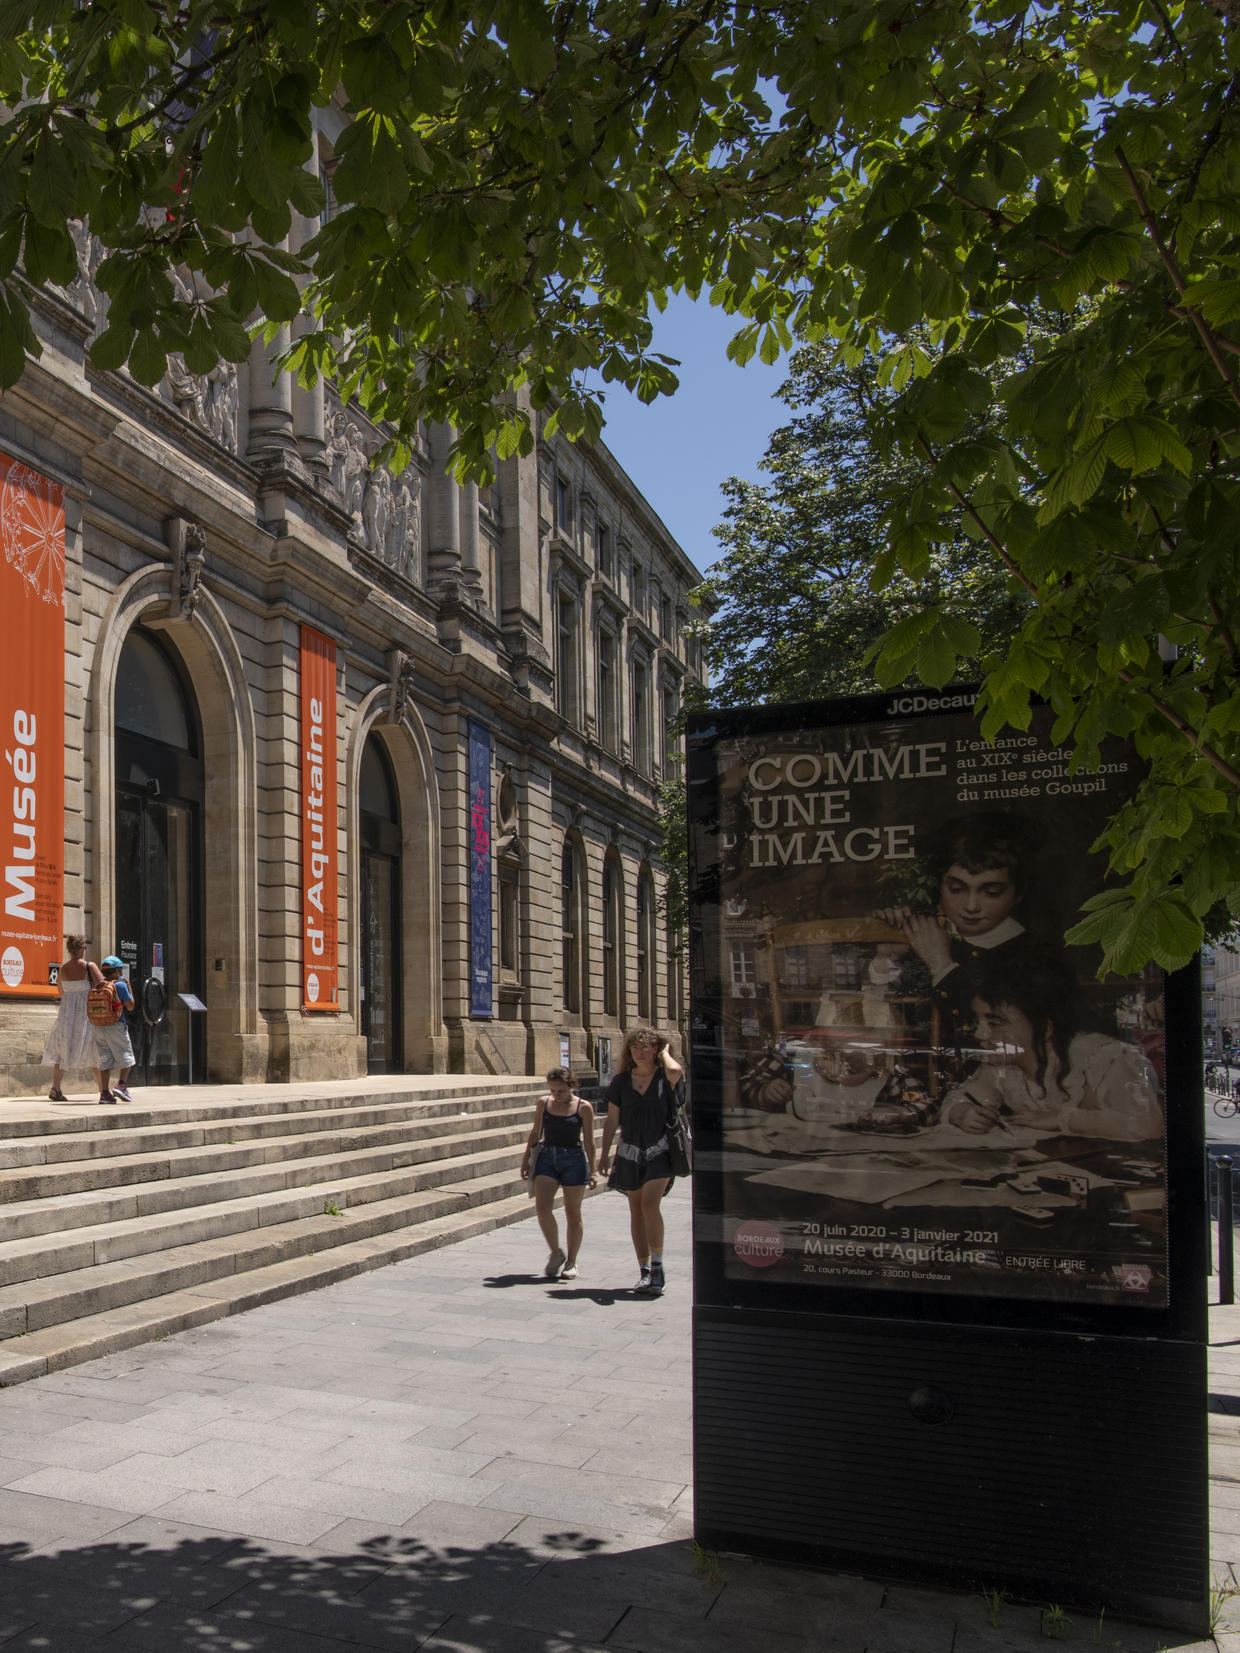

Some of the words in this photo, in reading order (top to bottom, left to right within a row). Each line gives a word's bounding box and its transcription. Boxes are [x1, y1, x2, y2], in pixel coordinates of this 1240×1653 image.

[887, 694, 979, 715] JCDecau
[748, 741, 947, 791] COMME
[957, 757, 976, 769] au
[1022, 748, 1074, 764] siècle
[957, 772, 998, 785] dans
[1002, 769, 1027, 782] les
[957, 788, 979, 801] du
[983, 784, 1041, 800] musée
[1045, 778, 1108, 797] Goupil
[5, 709, 36, 922] Musée
[749, 789, 851, 829] UNE
[307, 697, 329, 956] d'Aquitaine
[749, 824, 916, 868] IMAGE
[737, 1234, 780, 1245] BORDEAUX
[802, 1223, 820, 1235] 20
[823, 1224, 847, 1238] juin
[850, 1225, 887, 1238] 2020
[900, 1228, 910, 1239] 3
[913, 1229, 960, 1243] janvier
[963, 1230, 1000, 1244] 2021
[734, 1243, 785, 1258] culture
[803, 1239, 866, 1258] Musée
[872, 1243, 987, 1265] d'Aquitaine
[1005, 1254, 1051, 1269] ENTRÉE
[1053, 1257, 1087, 1270] LIBRE
[818, 1266, 841, 1274] cours
[842, 1266, 874, 1276] Pasteur
[911, 1271, 952, 1281] Bordeaux
